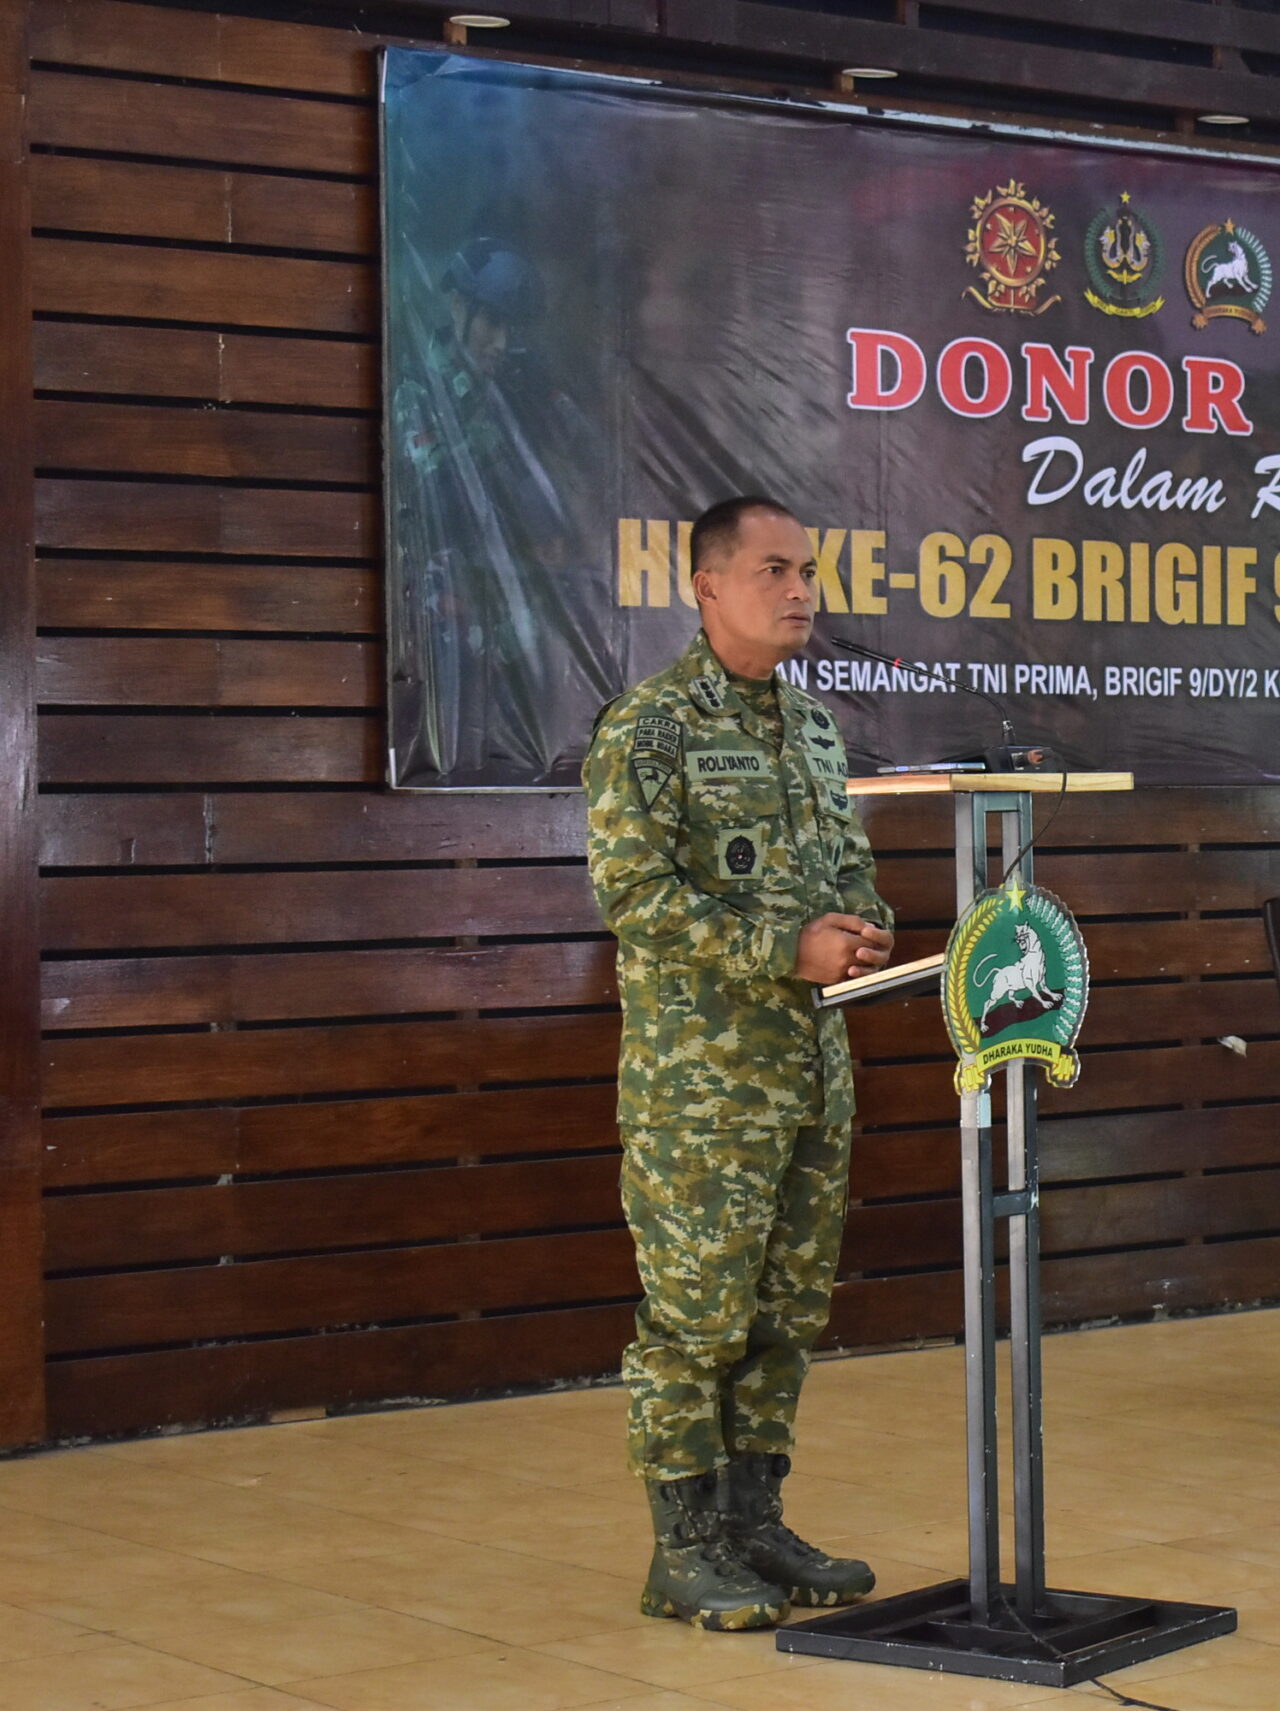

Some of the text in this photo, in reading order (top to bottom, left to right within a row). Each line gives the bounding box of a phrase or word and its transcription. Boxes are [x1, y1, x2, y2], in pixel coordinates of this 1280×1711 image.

[846, 327, 1254, 436] DONOR
[1022, 435, 1227, 514] Dalam
[1033, 537, 1258, 626] BRIGIF
[817, 659, 957, 692] SEMANGAT
[967, 662, 1008, 695] TNI
[1015, 664, 1098, 700] PRIMA,
[1105, 666, 1182, 697] BRIGIF
[1190, 668, 1258, 698] 9/DY/2
[642, 718, 676, 731] CAKRA
[812, 757, 835, 775] TNI
[982, 1043, 1054, 1066] DHARAKA YUDHA
